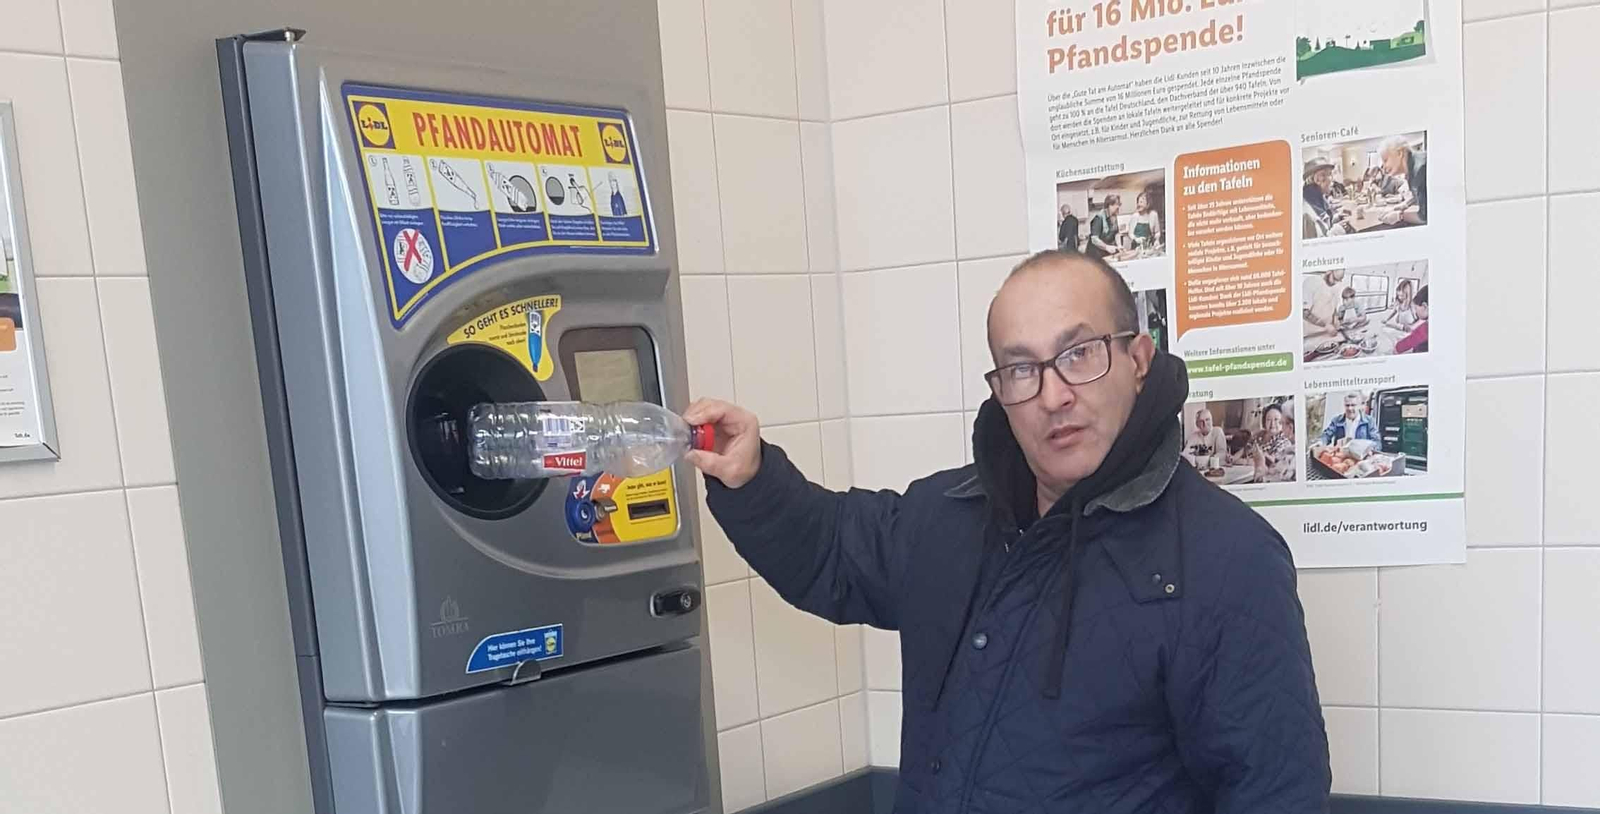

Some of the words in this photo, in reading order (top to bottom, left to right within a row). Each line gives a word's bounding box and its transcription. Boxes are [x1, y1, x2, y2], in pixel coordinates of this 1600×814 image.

[1046, 8, 1086, 38] für
[1093, 0, 1121, 28] 16
[1047, 15, 1243, 74] Pfandspende!
[1154, 76, 1162, 84] die
[1276, 56, 1286, 64] die
[412, 112, 583, 158] PFANDAUTOMAT
[1183, 159, 1260, 179] Informationen
[1183, 185, 1196, 196] zu
[1197, 181, 1217, 194] den
[1219, 174, 1253, 191] Tafeln
[1302, 257, 1344, 268] Kochkurse
[463, 325, 476, 339] SO
[477, 313, 499, 331] GEHT
[499, 308, 509, 321] ES
[511, 298, 559, 317] SCHNELLER!
[1184, 349, 1208, 358] Weitere
[1209, 345, 1257, 356] Informationen
[1257, 344, 1275, 352] unter
[1304, 375, 1396, 390] Lebensmitteltransport
[554, 456, 583, 467] Vittel
[1303, 520, 1428, 534] lidl.de/verantwortung
[431, 622, 470, 639] TOMRA
